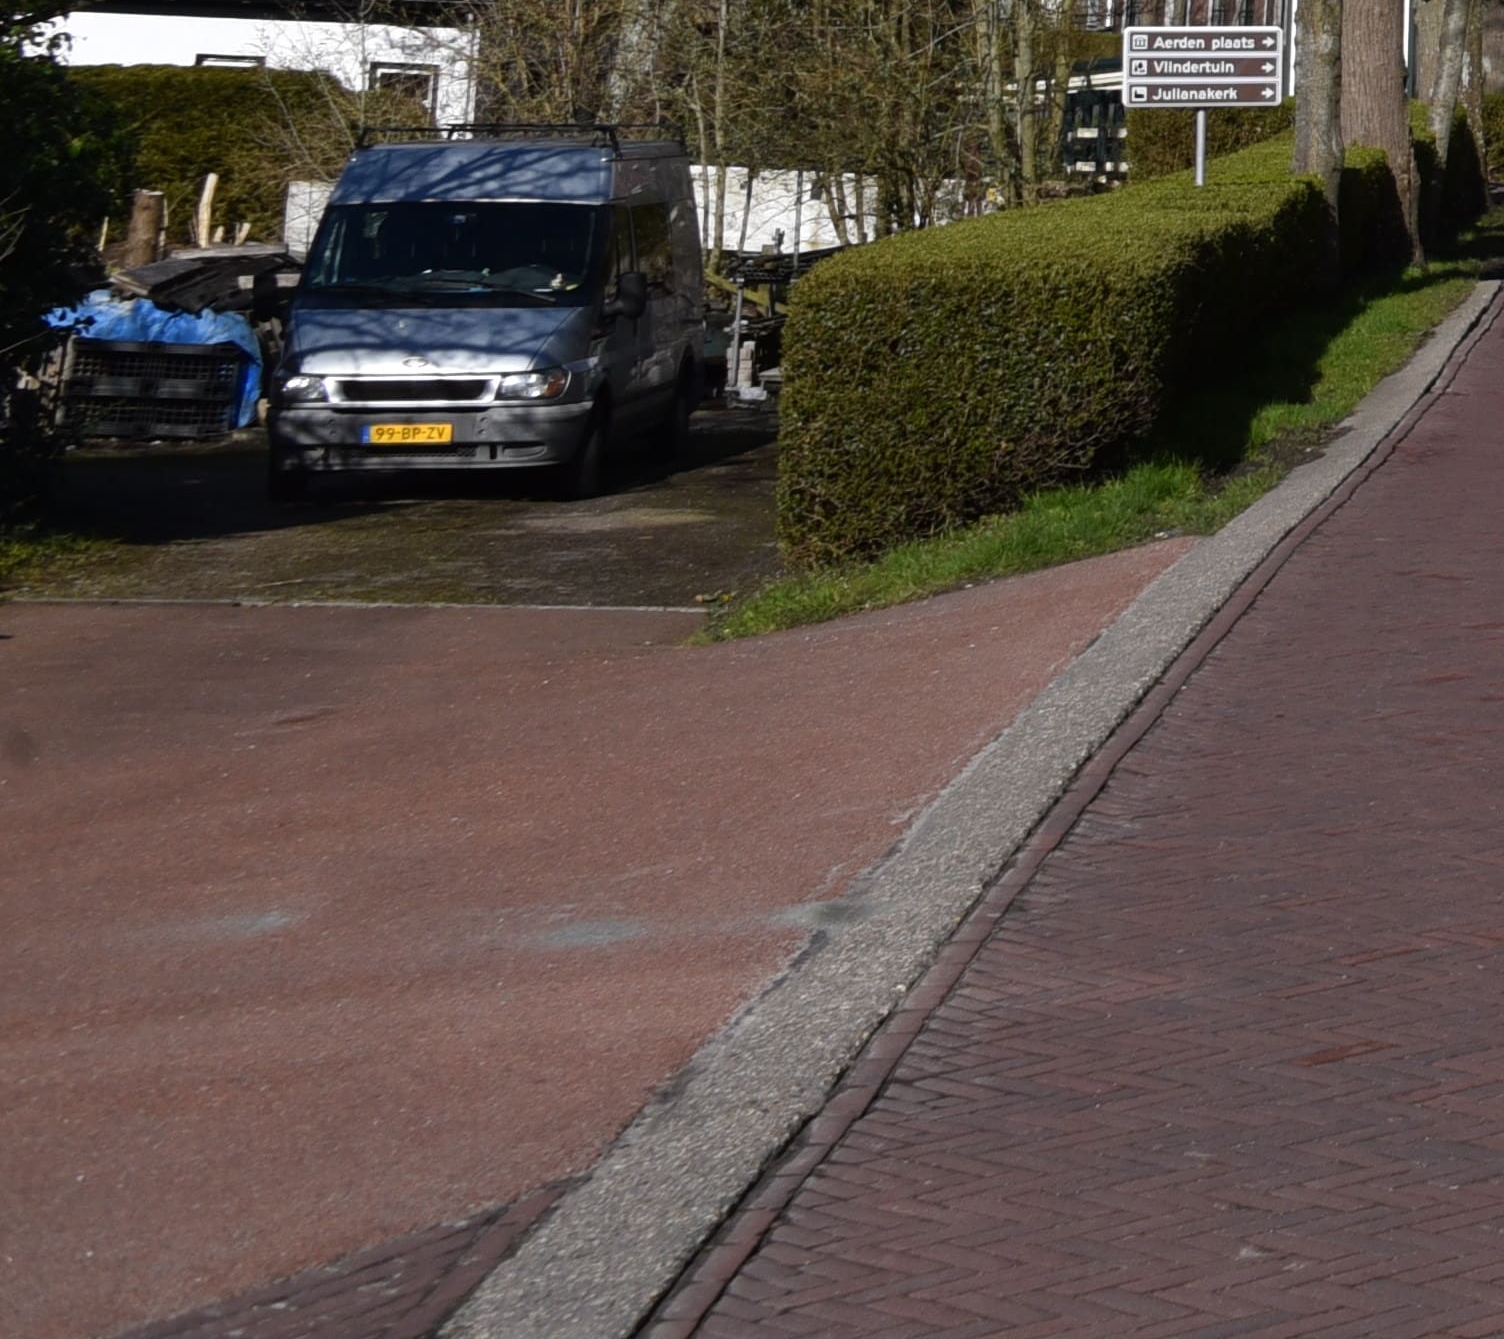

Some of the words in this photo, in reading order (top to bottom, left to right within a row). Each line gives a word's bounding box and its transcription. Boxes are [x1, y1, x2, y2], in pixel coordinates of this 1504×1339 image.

[1153, 36, 1205, 49] Aerden
[1211, 36, 1255, 51] plaats
[1153, 60, 1235, 74] Vlindertuin
[1152, 87, 1238, 101] Julianakerk
[375, 427, 446, 440] 99-BP-ZV
